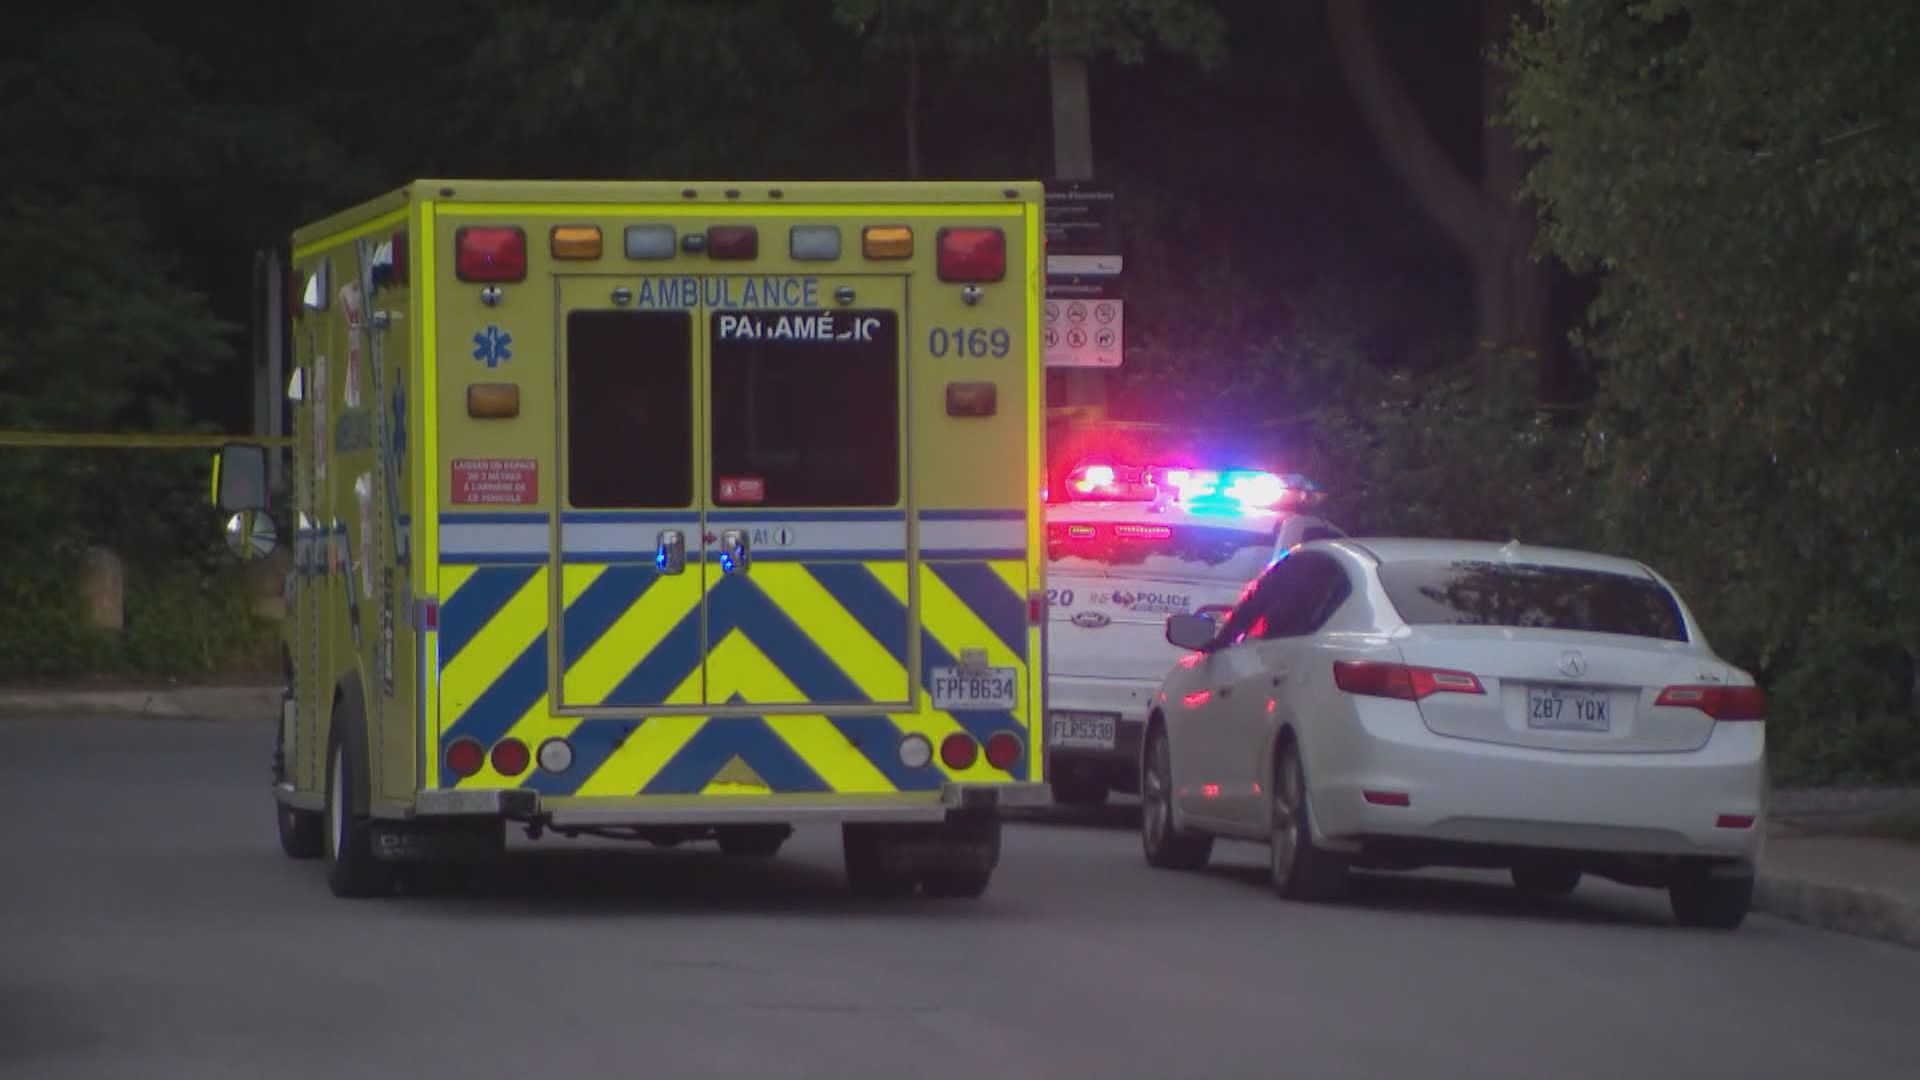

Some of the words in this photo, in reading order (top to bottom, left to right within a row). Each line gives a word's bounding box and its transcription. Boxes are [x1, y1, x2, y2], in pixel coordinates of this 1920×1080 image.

[638, 276, 819, 308] AMBULANCE
[928, 326, 1010, 359] 0169
[1136, 591, 1190, 607] POLICE
[1533, 697, 1563, 719] Z87
